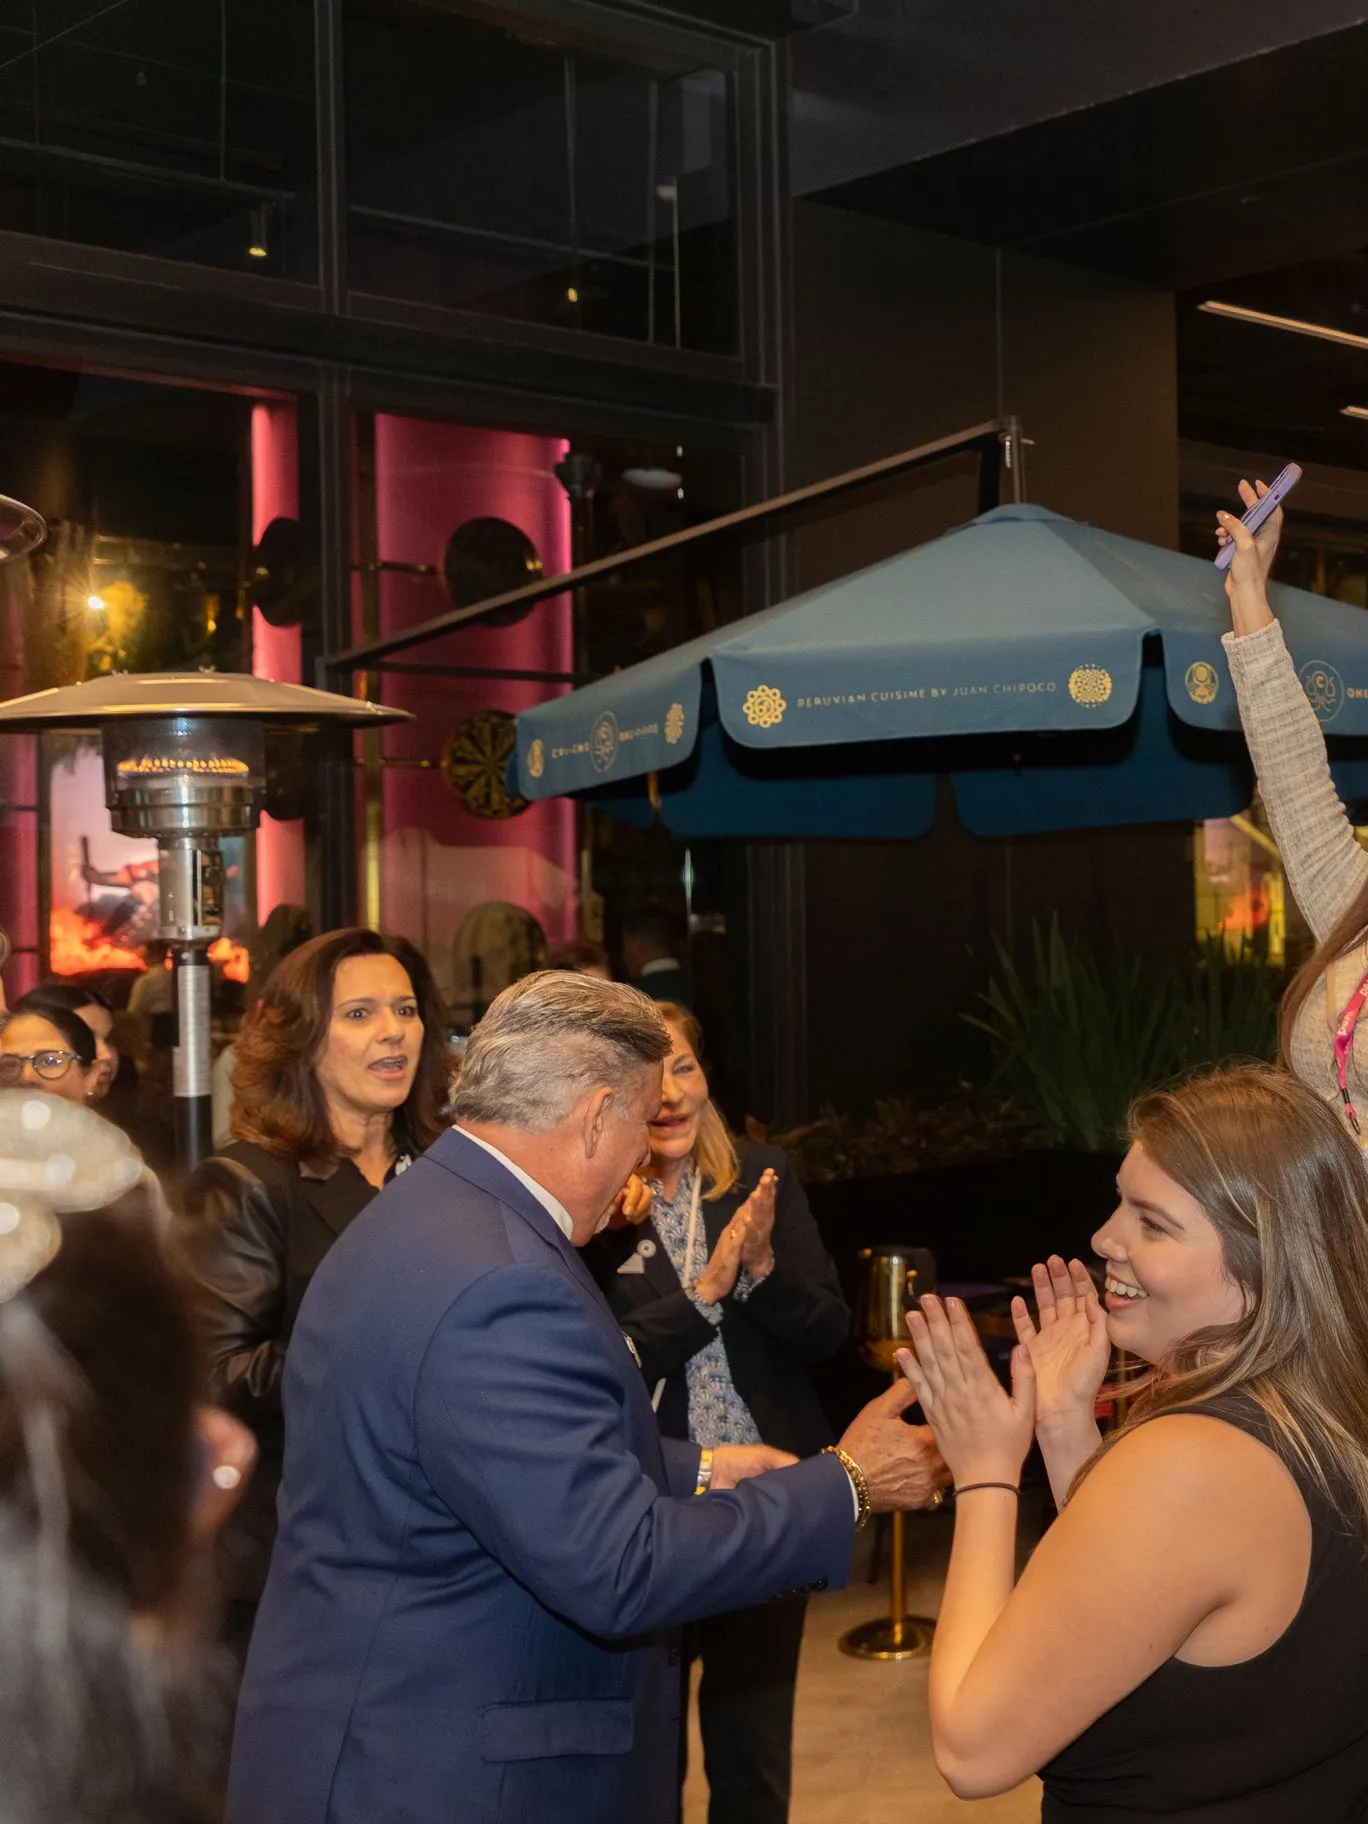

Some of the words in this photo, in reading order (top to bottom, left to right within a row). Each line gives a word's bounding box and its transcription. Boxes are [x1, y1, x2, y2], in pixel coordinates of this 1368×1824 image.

[797, 692, 867, 708] PERUVIAN
[870, 688, 926, 702] CUISINE
[930, 687, 948, 698] BY
[953, 684, 988, 697] JUAN
[993, 681, 1057, 695] CHIPOCO
